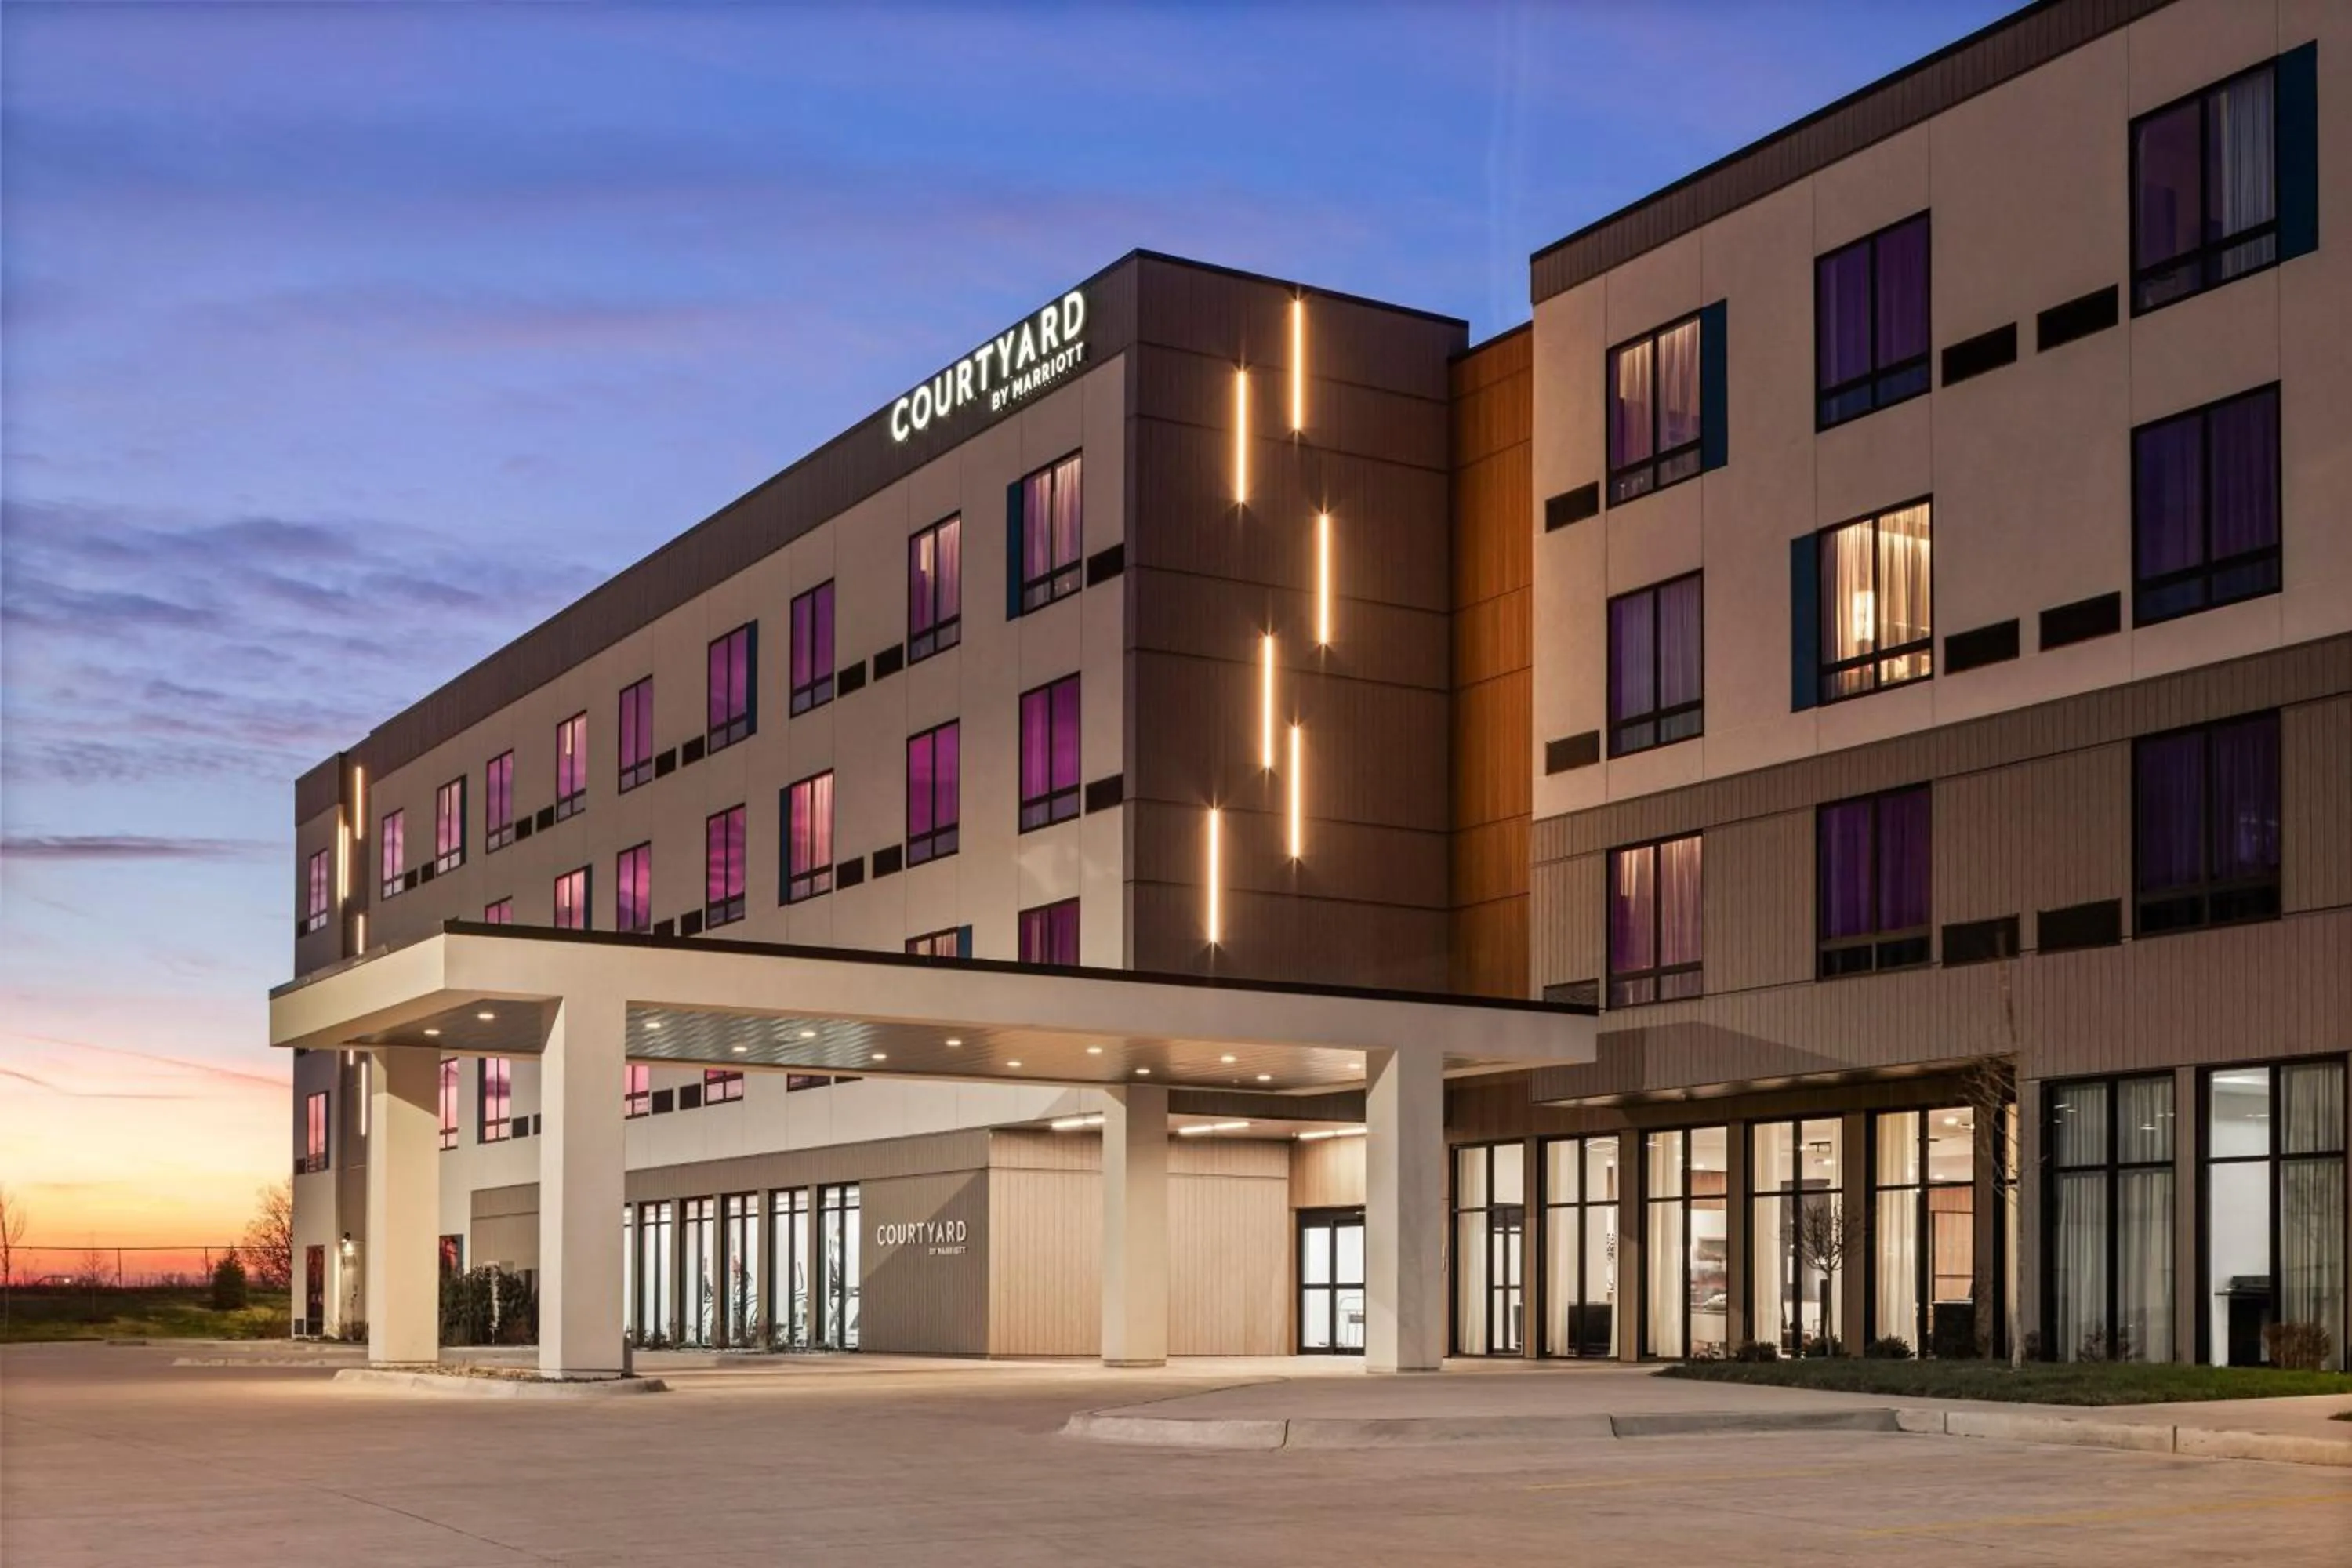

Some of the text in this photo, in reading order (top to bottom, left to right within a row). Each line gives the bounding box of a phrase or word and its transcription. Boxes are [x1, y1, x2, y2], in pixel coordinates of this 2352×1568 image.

[891, 291, 1084, 441] COURTYARD
[991, 342, 1084, 412] BY MARRIOTT
[877, 1221, 967, 1246] COURTYARD
